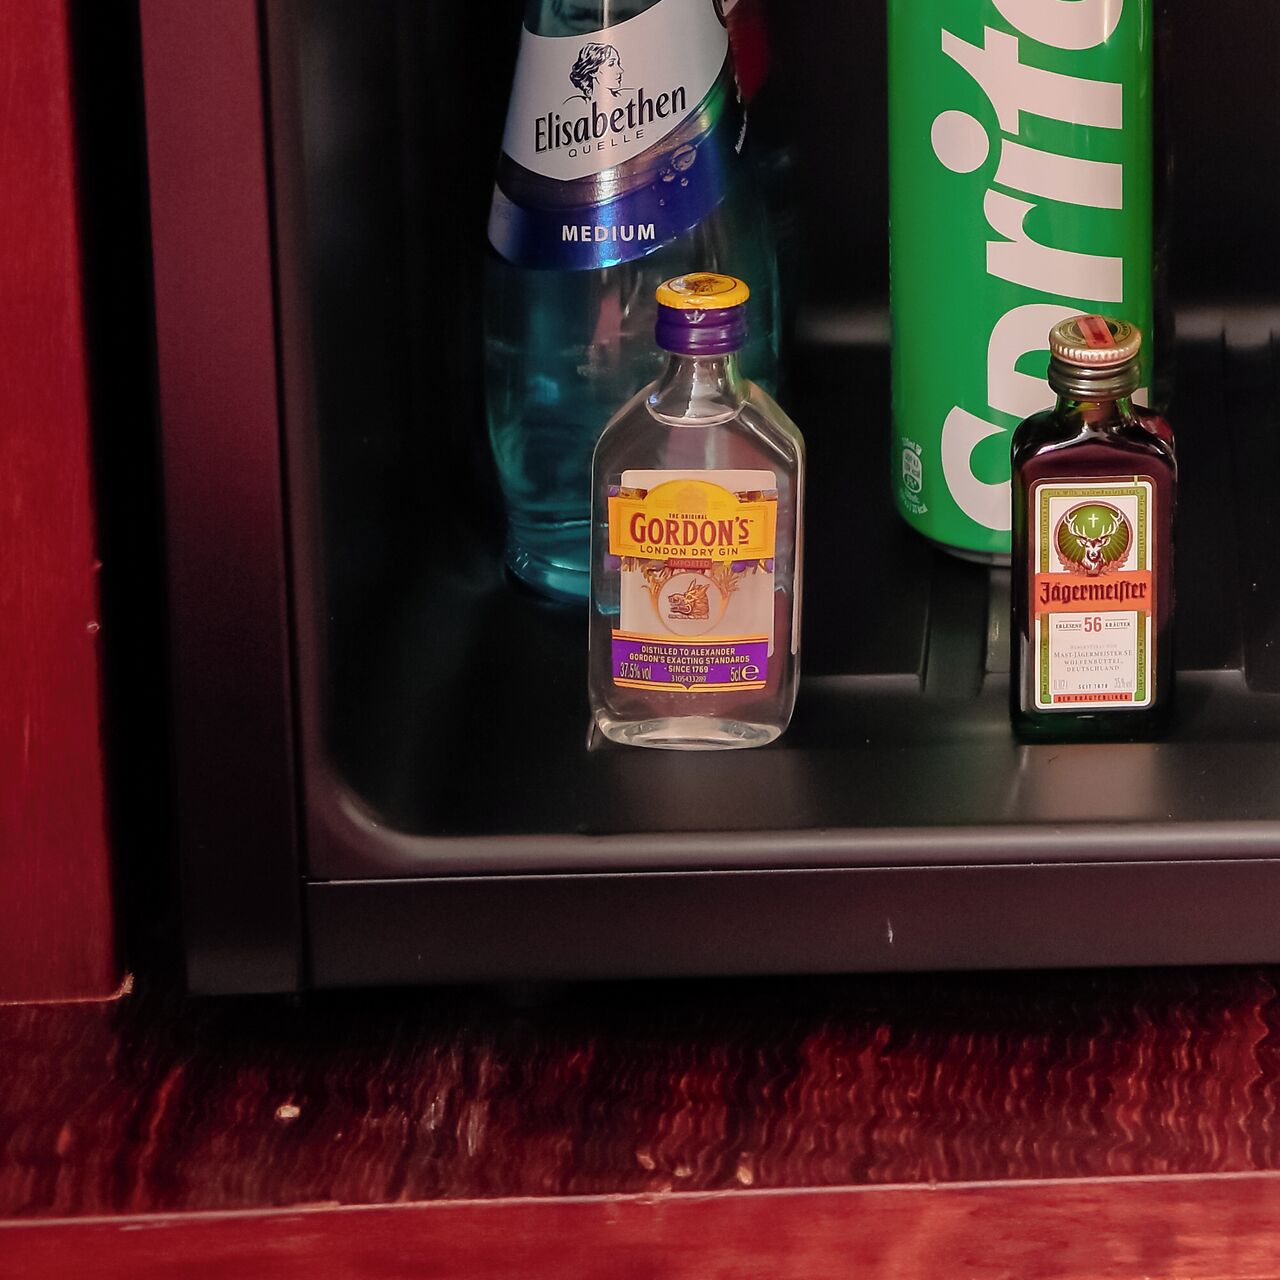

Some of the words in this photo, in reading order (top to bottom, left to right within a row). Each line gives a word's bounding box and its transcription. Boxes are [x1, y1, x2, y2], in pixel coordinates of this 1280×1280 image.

[534, 85, 687, 153] Elisabethen
[568, 128, 645, 158] QUELLE
[561, 223, 656, 242] MEDIUM
[629, 512, 750, 547] GORDON'S
[640, 544, 687, 557] LONDON
[691, 547, 715, 557] DRY
[718, 546, 739, 557] GIN
[1084, 616, 1102, 632] 56
[641, 645, 678, 656] DISTILLED
[679, 648, 690, 656] TO
[691, 647, 736, 656] ALEXANDER
[629, 653, 666, 663] GORDON'S
[666, 656, 705, 665] EXACTING
[705, 655, 750, 665] STANDARDS
[619, 662, 641, 678] 37.5%
[641, 665, 652, 680] vol
[668, 665, 690, 673] SINCE
[730, 666, 741, 682] 5cl
